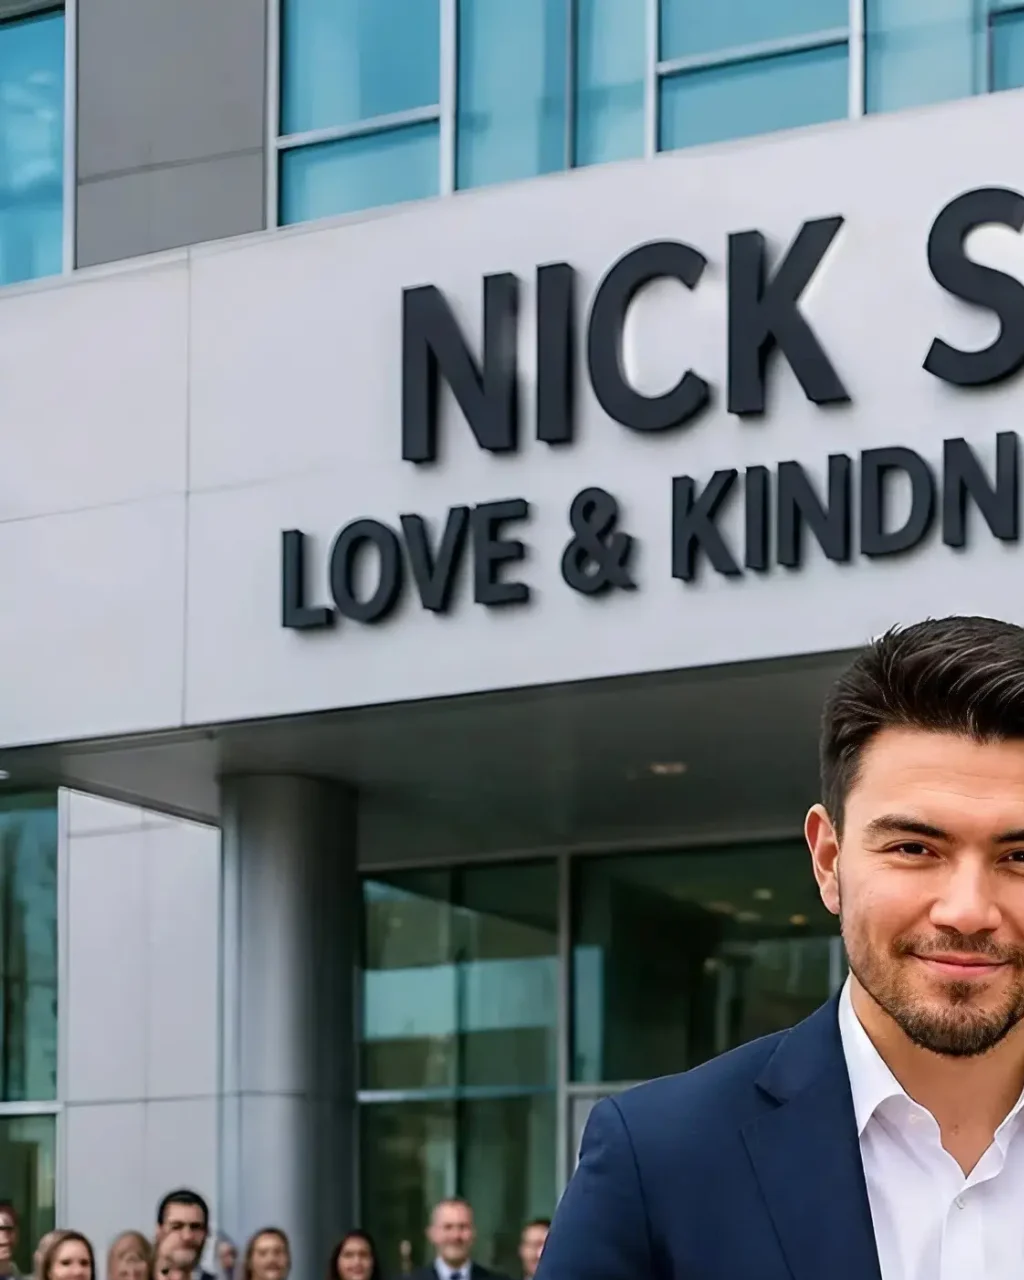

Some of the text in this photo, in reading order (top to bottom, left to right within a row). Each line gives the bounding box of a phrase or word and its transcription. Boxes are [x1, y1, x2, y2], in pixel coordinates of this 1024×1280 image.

[401, 215, 854, 464] NICK
[281, 498, 533, 630] LOVE
[560, 486, 640, 598] &
